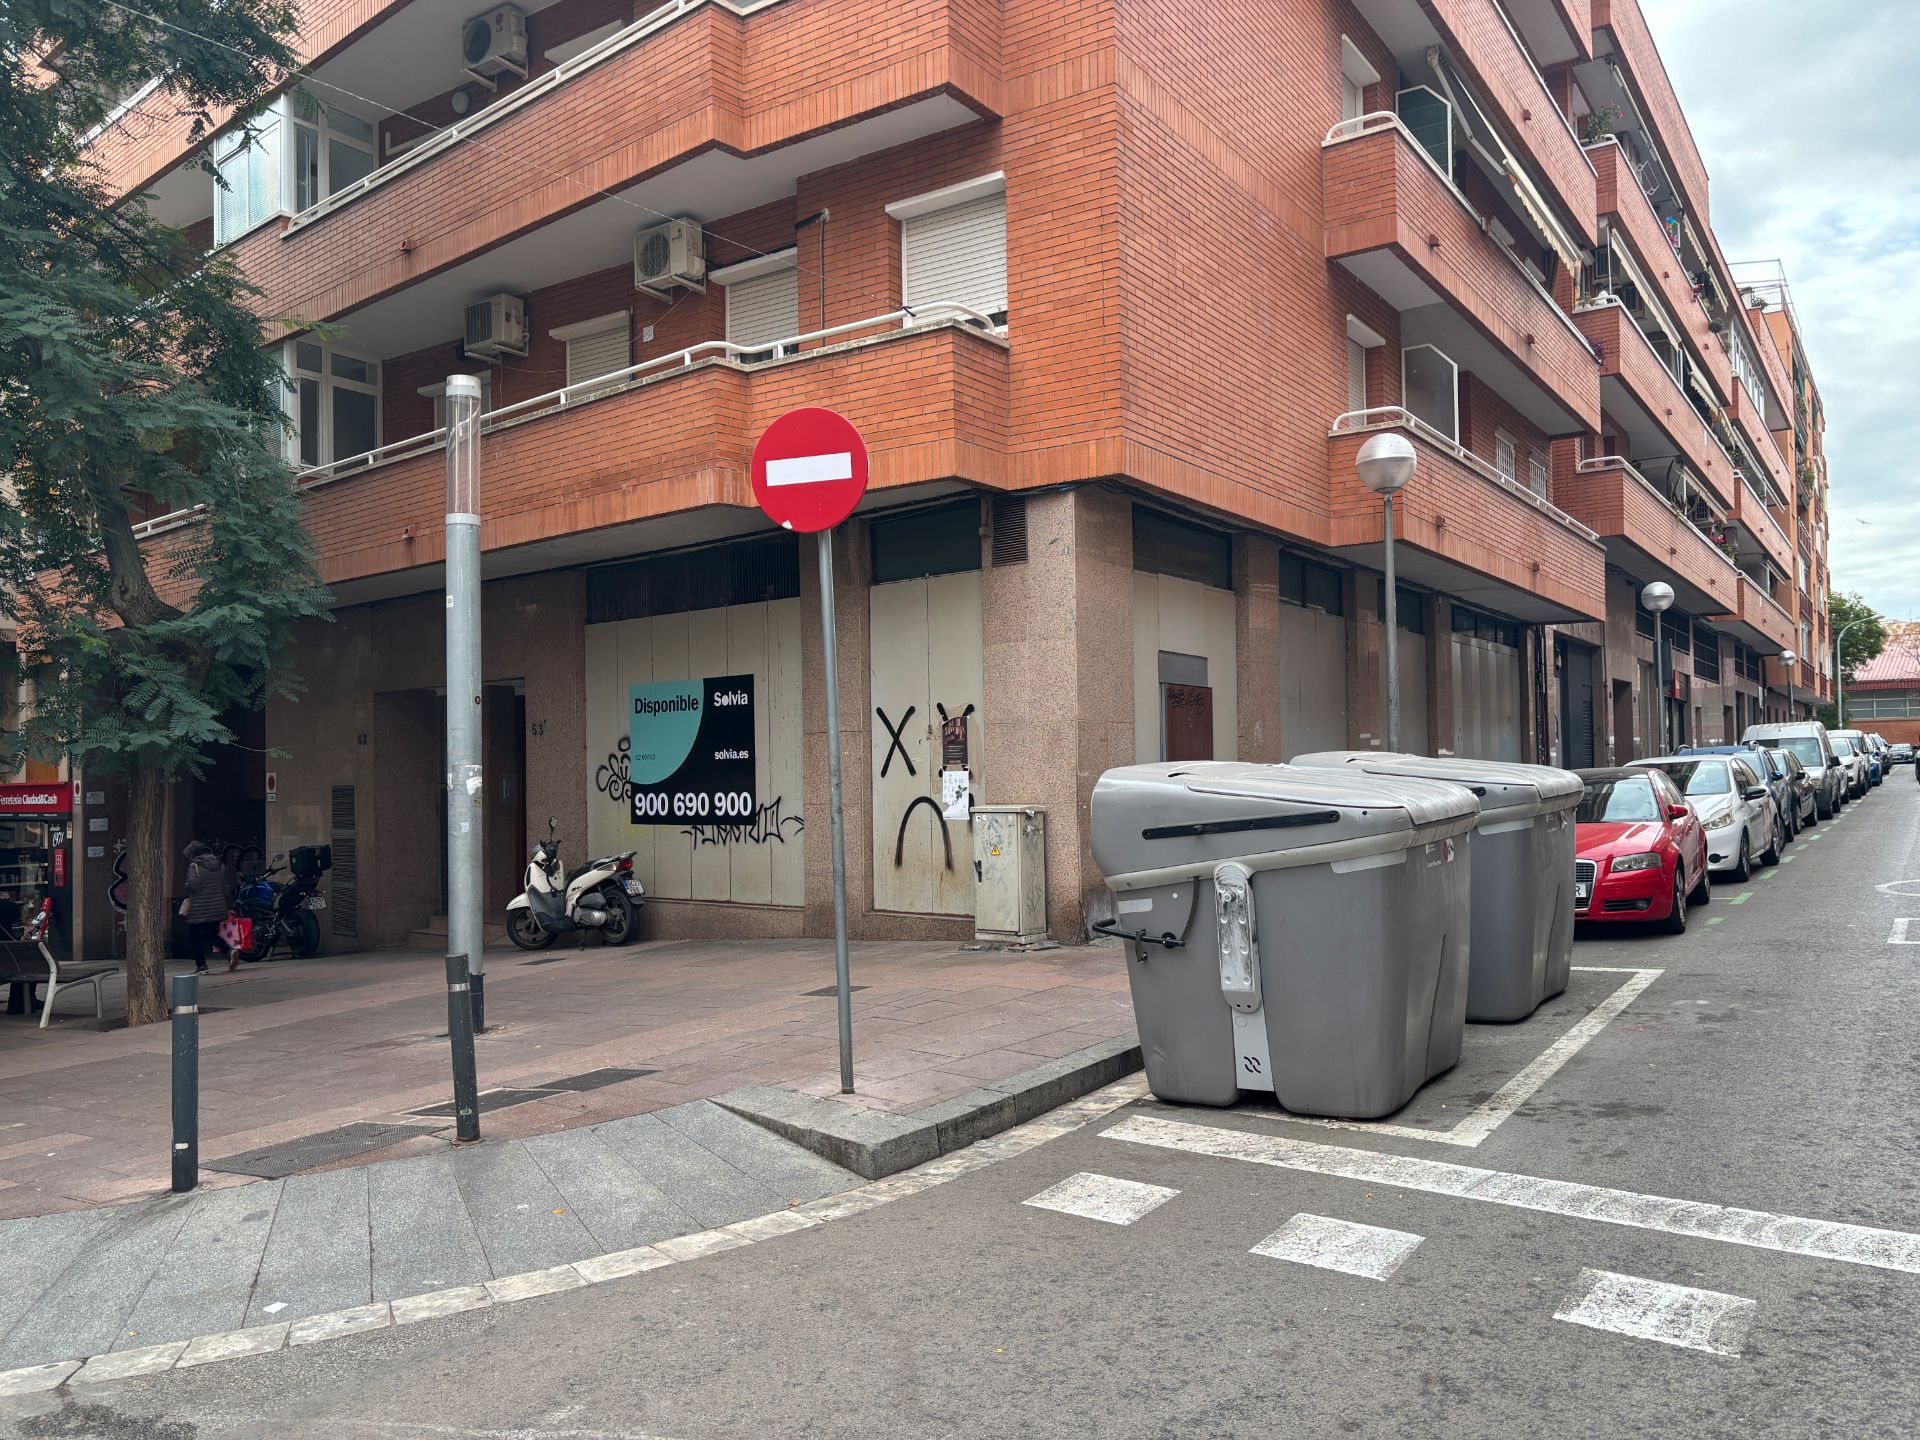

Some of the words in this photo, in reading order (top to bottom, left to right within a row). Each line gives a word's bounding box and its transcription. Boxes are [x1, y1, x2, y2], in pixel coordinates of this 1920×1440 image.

[634, 694, 699, 717] Disponible
[714, 691, 748, 707] Solvia
[714, 749, 749, 760] solvia.es
[634, 792, 669, 816] 900
[673, 792, 709, 817] 690
[714, 791, 752, 817] 900
